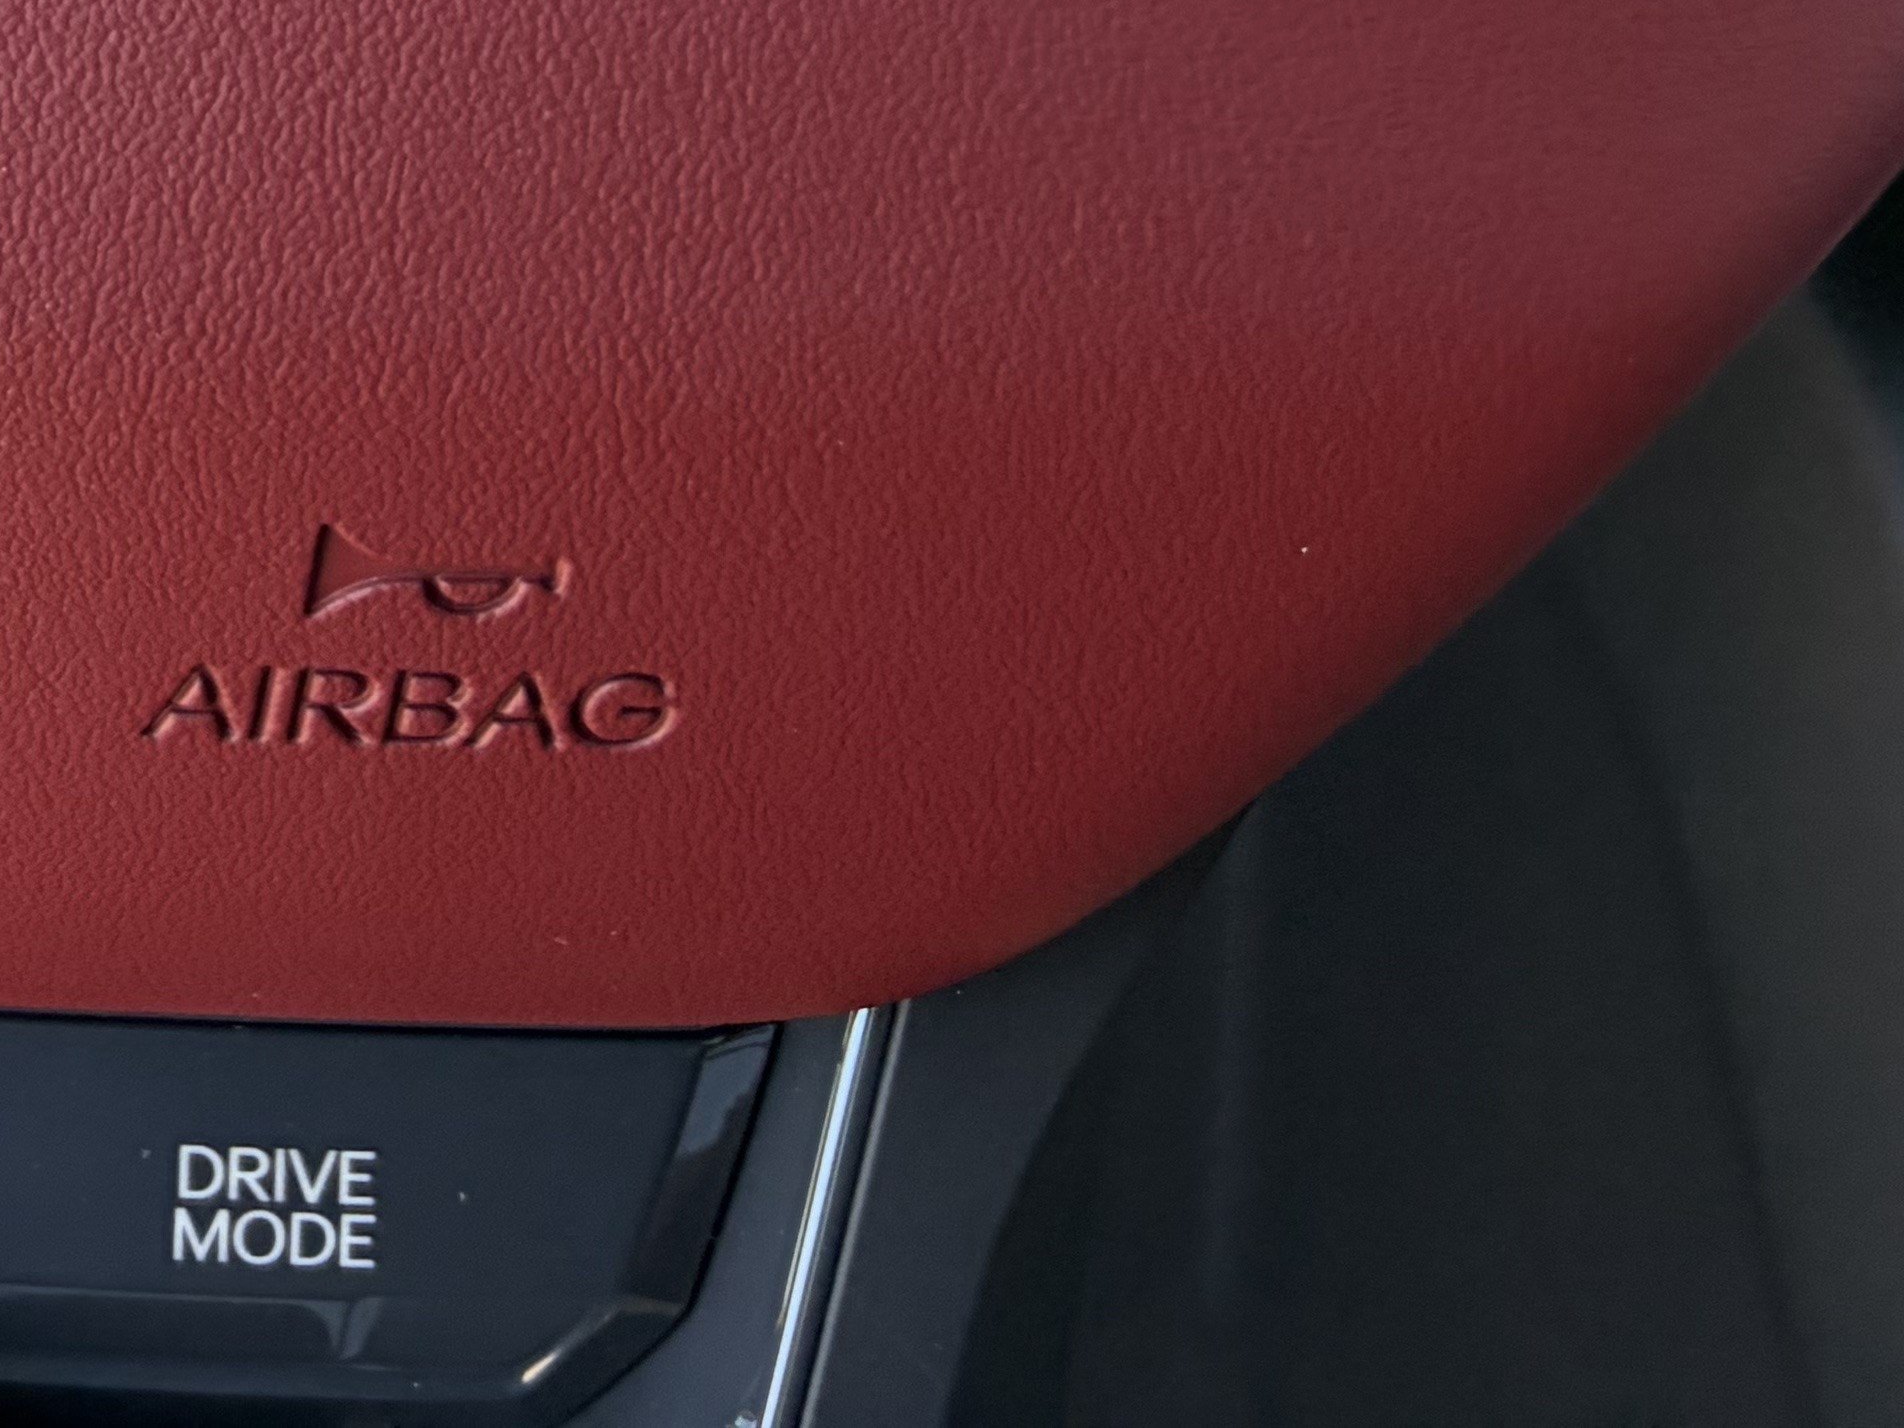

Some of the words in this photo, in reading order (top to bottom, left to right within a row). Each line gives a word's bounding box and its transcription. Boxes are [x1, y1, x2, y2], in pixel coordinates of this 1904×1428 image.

[141, 663, 680, 750] AIRBAG
[178, 1144, 377, 1206] DRIVE
[172, 1207, 377, 1268] MODE
